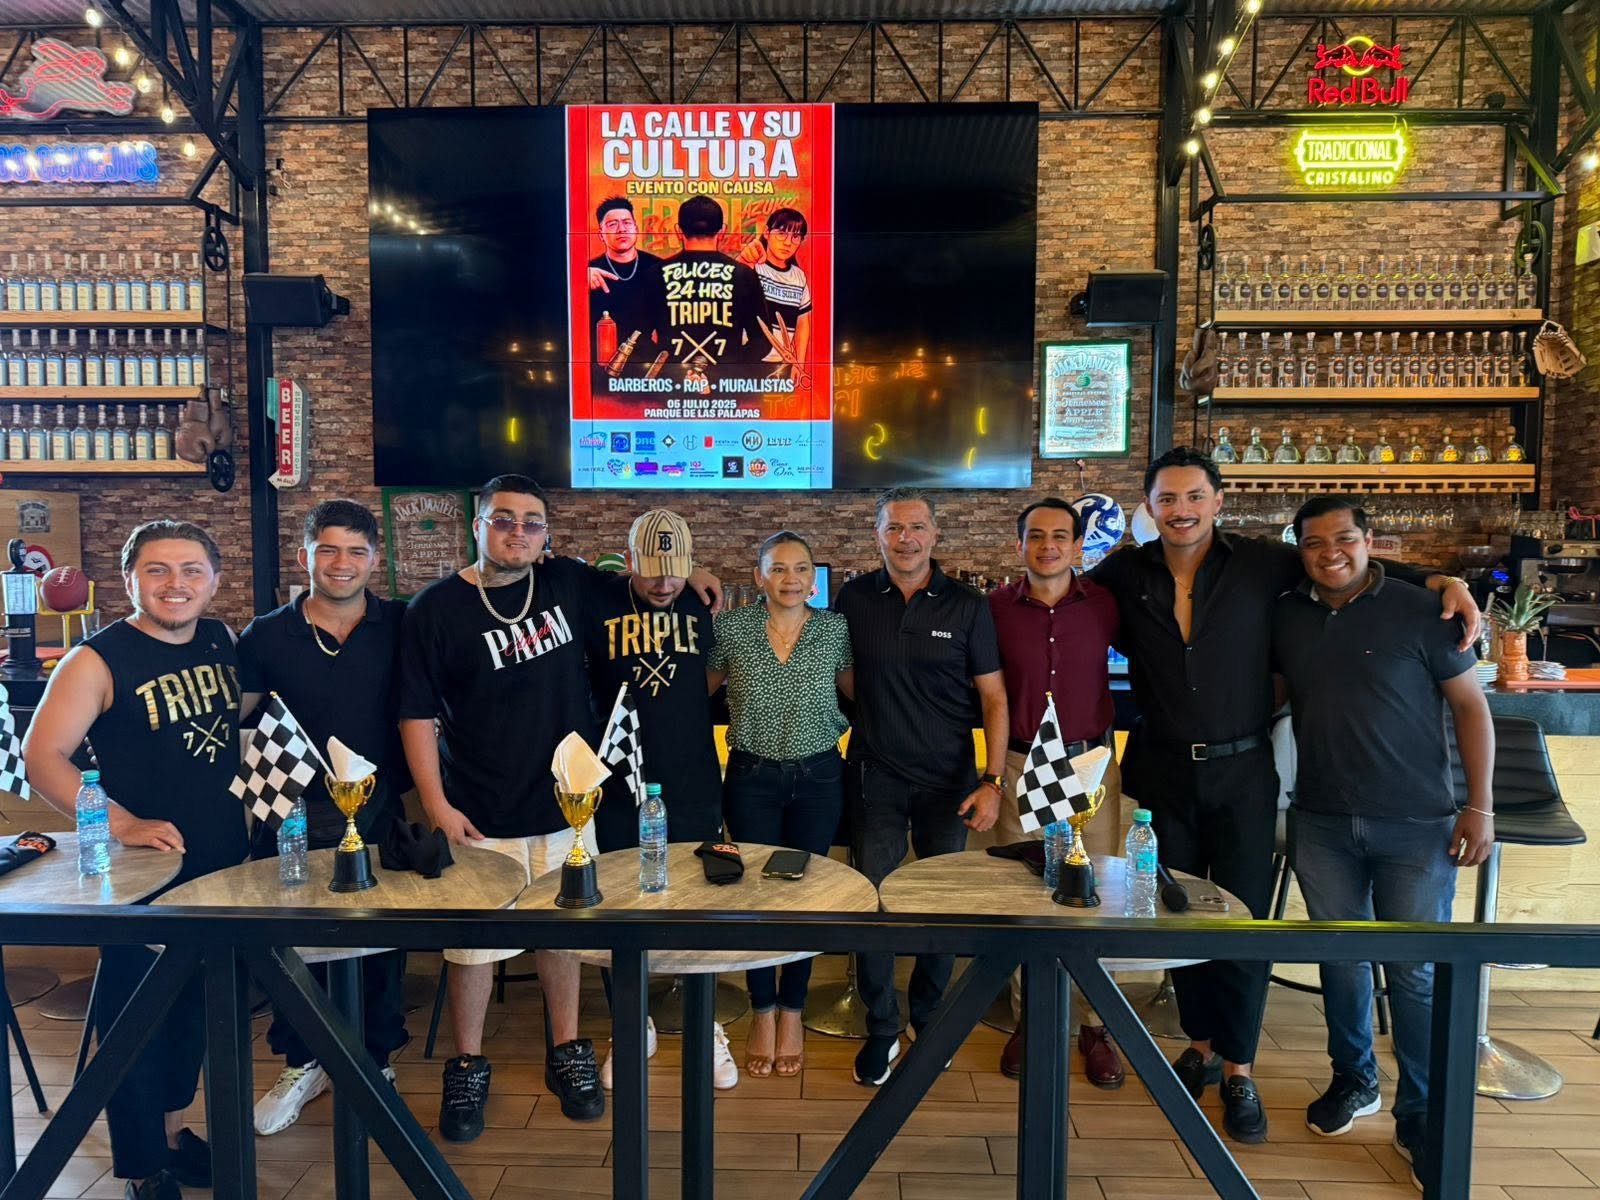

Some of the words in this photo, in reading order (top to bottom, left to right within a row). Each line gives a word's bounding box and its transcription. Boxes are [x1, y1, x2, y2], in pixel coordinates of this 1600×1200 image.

[1308, 77, 1357, 104] Red
[1361, 76, 1409, 104] Bull
[601, 111, 638, 138] LA
[644, 111, 730, 138] CALLE
[737, 111, 757, 138] Y
[763, 110, 802, 138] SU
[603, 138, 799, 179] CULTURA
[1306, 140, 1394, 161] TRADICIONAL
[1305, 171, 1395, 185] CRISTALINO
[626, 181, 685, 195] EVENTO
[687, 181, 720, 195] CON
[723, 181, 774, 195] CAUSA
[666, 280, 696, 300] 24
[698, 282, 734, 300] HRS
[667, 301, 733, 328] TRIPLE
[671, 338, 683, 356] 7
[714, 338, 727, 356] 7
[609, 378, 673, 393] BARBEROS
[684, 378, 709, 393] RAP
[719, 378, 795, 393] MURALISTAS
[667, 400, 681, 409] 05
[682, 400, 709, 409] JULIO
[711, 400, 737, 409] 2025
[644, 409, 682, 419] PARQUE
[683, 409, 696, 418] DE
[698, 409, 715, 418] LAS
[717, 409, 760, 418] PALAPAS
[281, 387, 291, 465] BEER
[412, 550, 449, 559] APPLE
[481, 605, 574, 671] PALM
[604, 611, 701, 660] TRIPLE
[931, 630, 953, 639] BOSS
[632, 666, 642, 682] 7
[668, 664, 677, 680] 7
[650, 681, 660, 697] 7
[183, 732, 194, 750] 7
[221, 723, 230, 741] 7
[206, 746, 217, 763] 7
